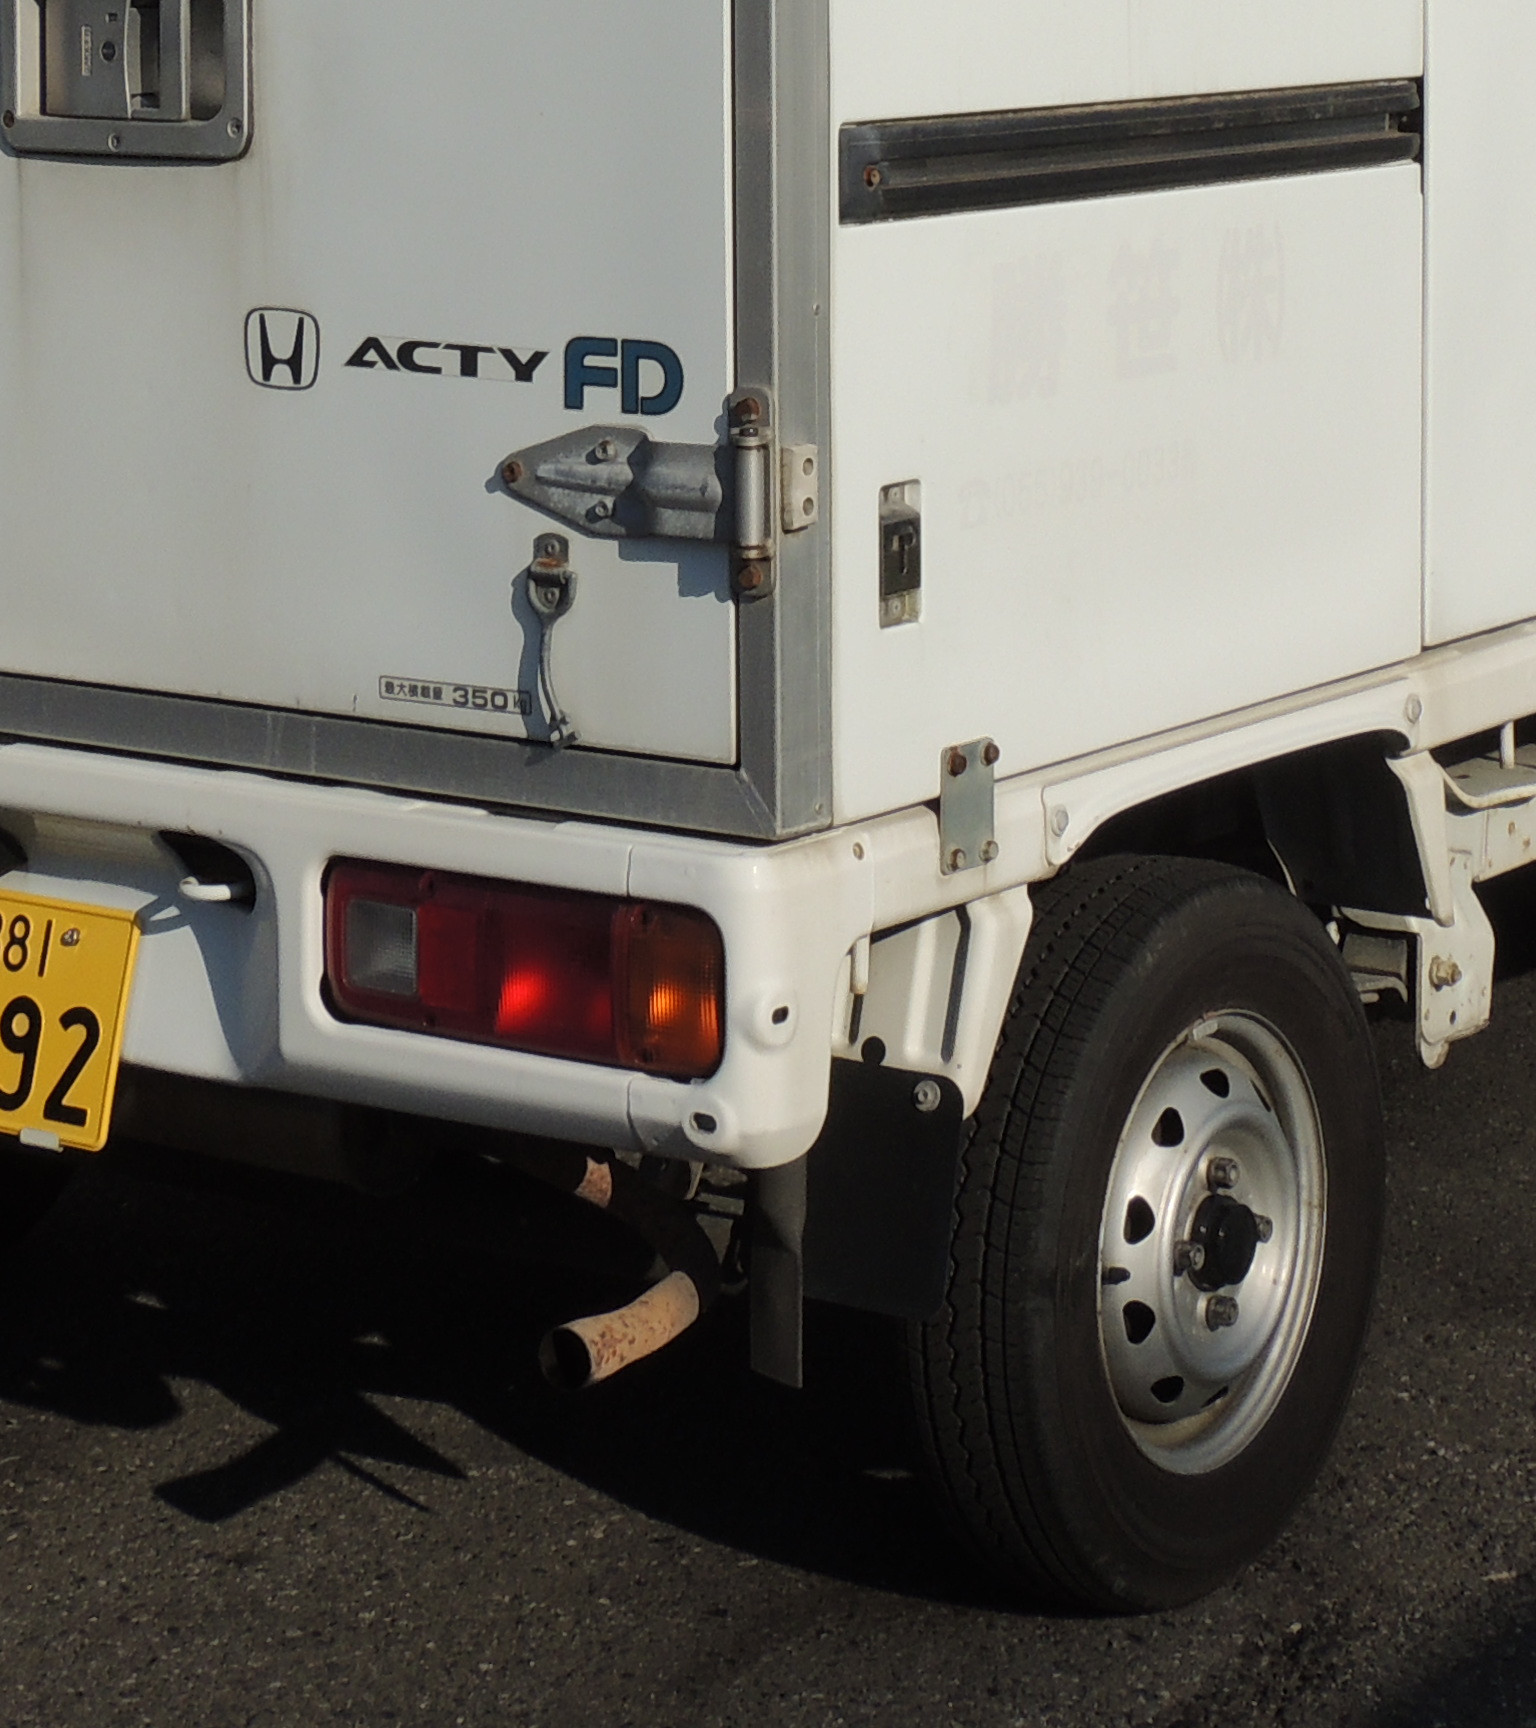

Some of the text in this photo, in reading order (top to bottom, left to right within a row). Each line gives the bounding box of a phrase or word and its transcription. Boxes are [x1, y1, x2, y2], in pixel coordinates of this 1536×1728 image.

[343, 336, 550, 383] ACTY
[563, 335, 685, 416] FD
[452, 686, 509, 710] 350
